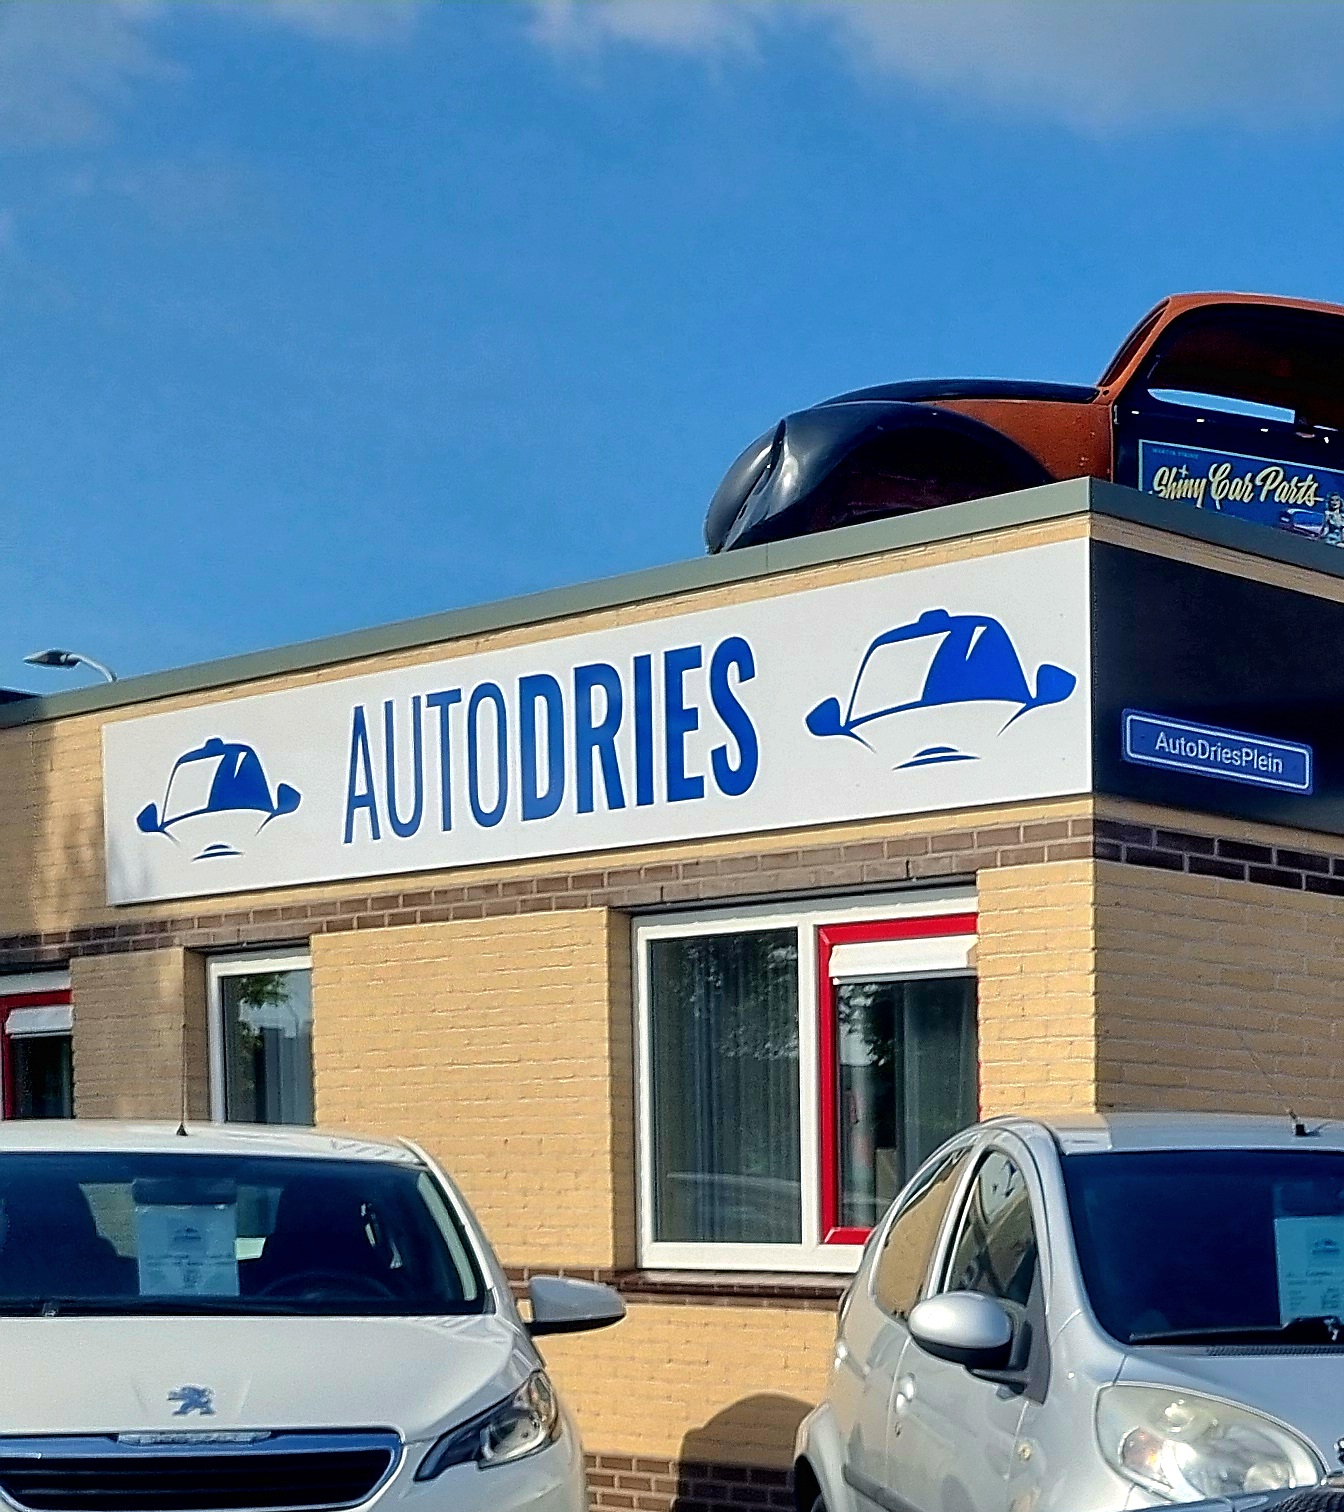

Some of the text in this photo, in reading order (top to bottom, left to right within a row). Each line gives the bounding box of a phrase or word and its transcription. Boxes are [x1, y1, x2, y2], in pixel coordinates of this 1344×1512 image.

[1153, 463, 1324, 510] Shiny Car Parts
[343, 636, 760, 845] AUTODRIES
[1155, 731, 1283, 774] AutoDriesPlein
